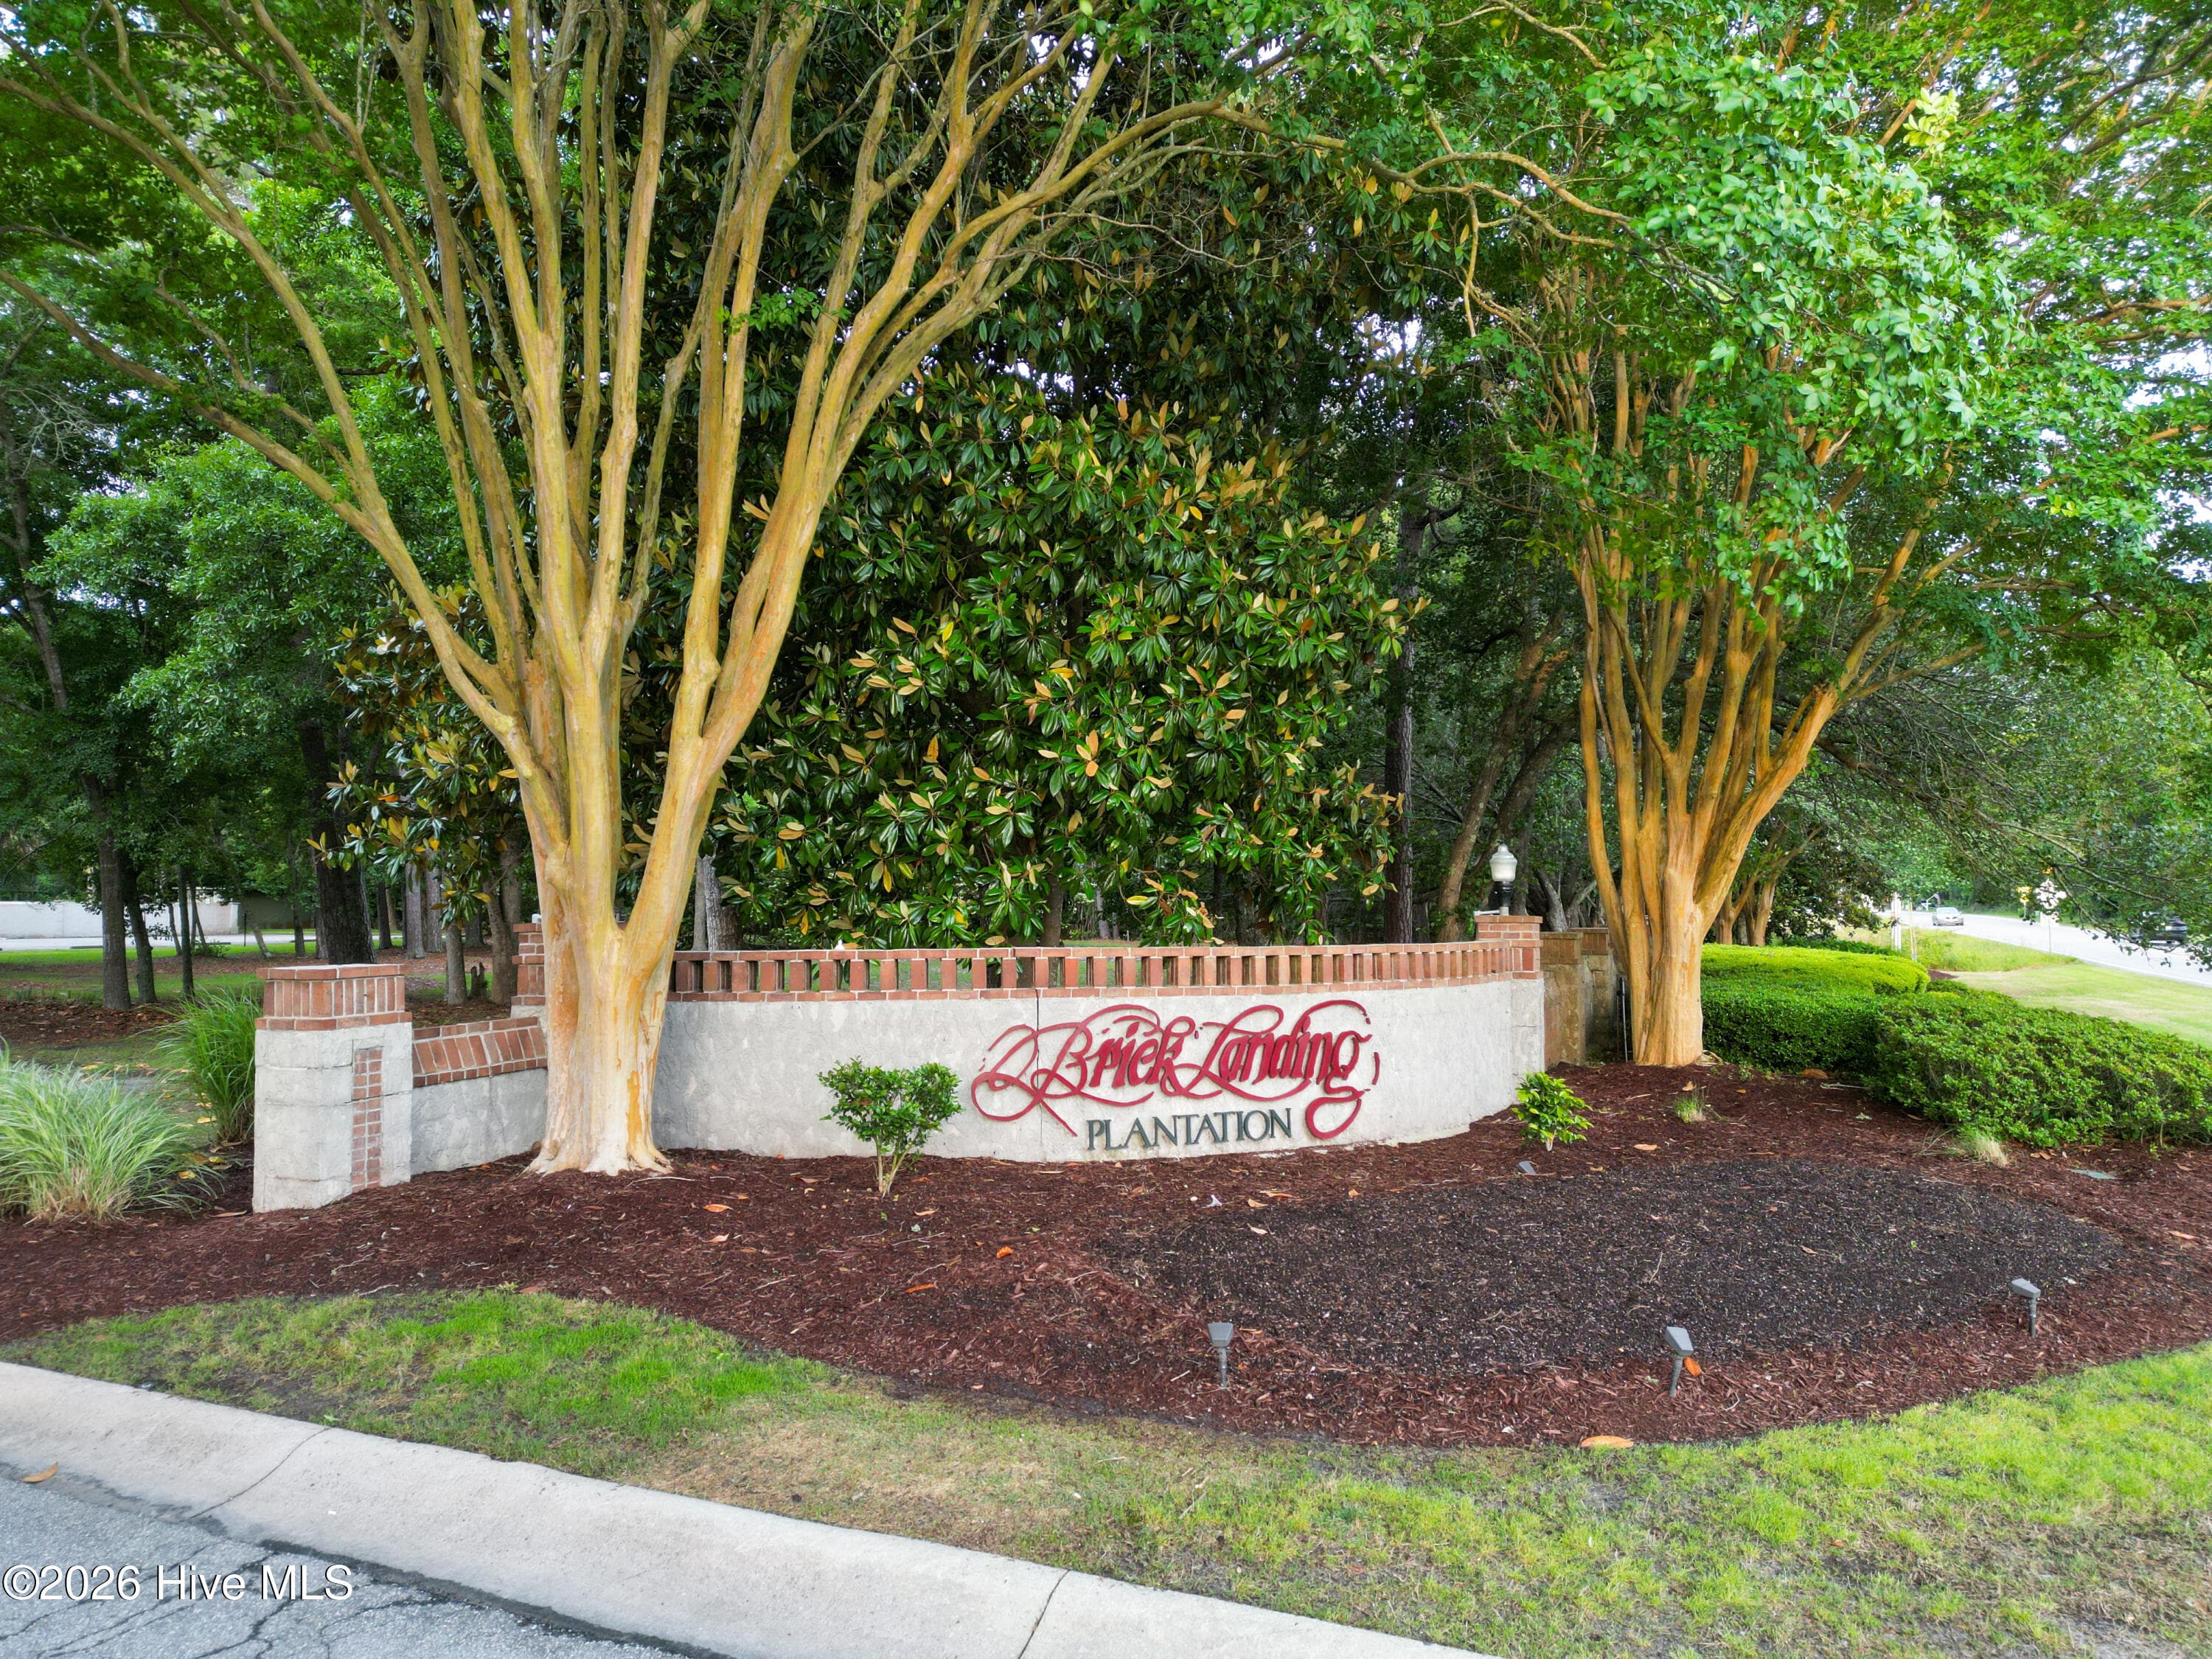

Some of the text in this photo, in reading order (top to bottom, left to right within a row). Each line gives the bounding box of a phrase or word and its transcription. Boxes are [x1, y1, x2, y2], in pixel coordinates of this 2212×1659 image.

[971, 1000, 1380, 1140] Brick Landing
[1086, 1107, 1292, 1151] PLANTATION
